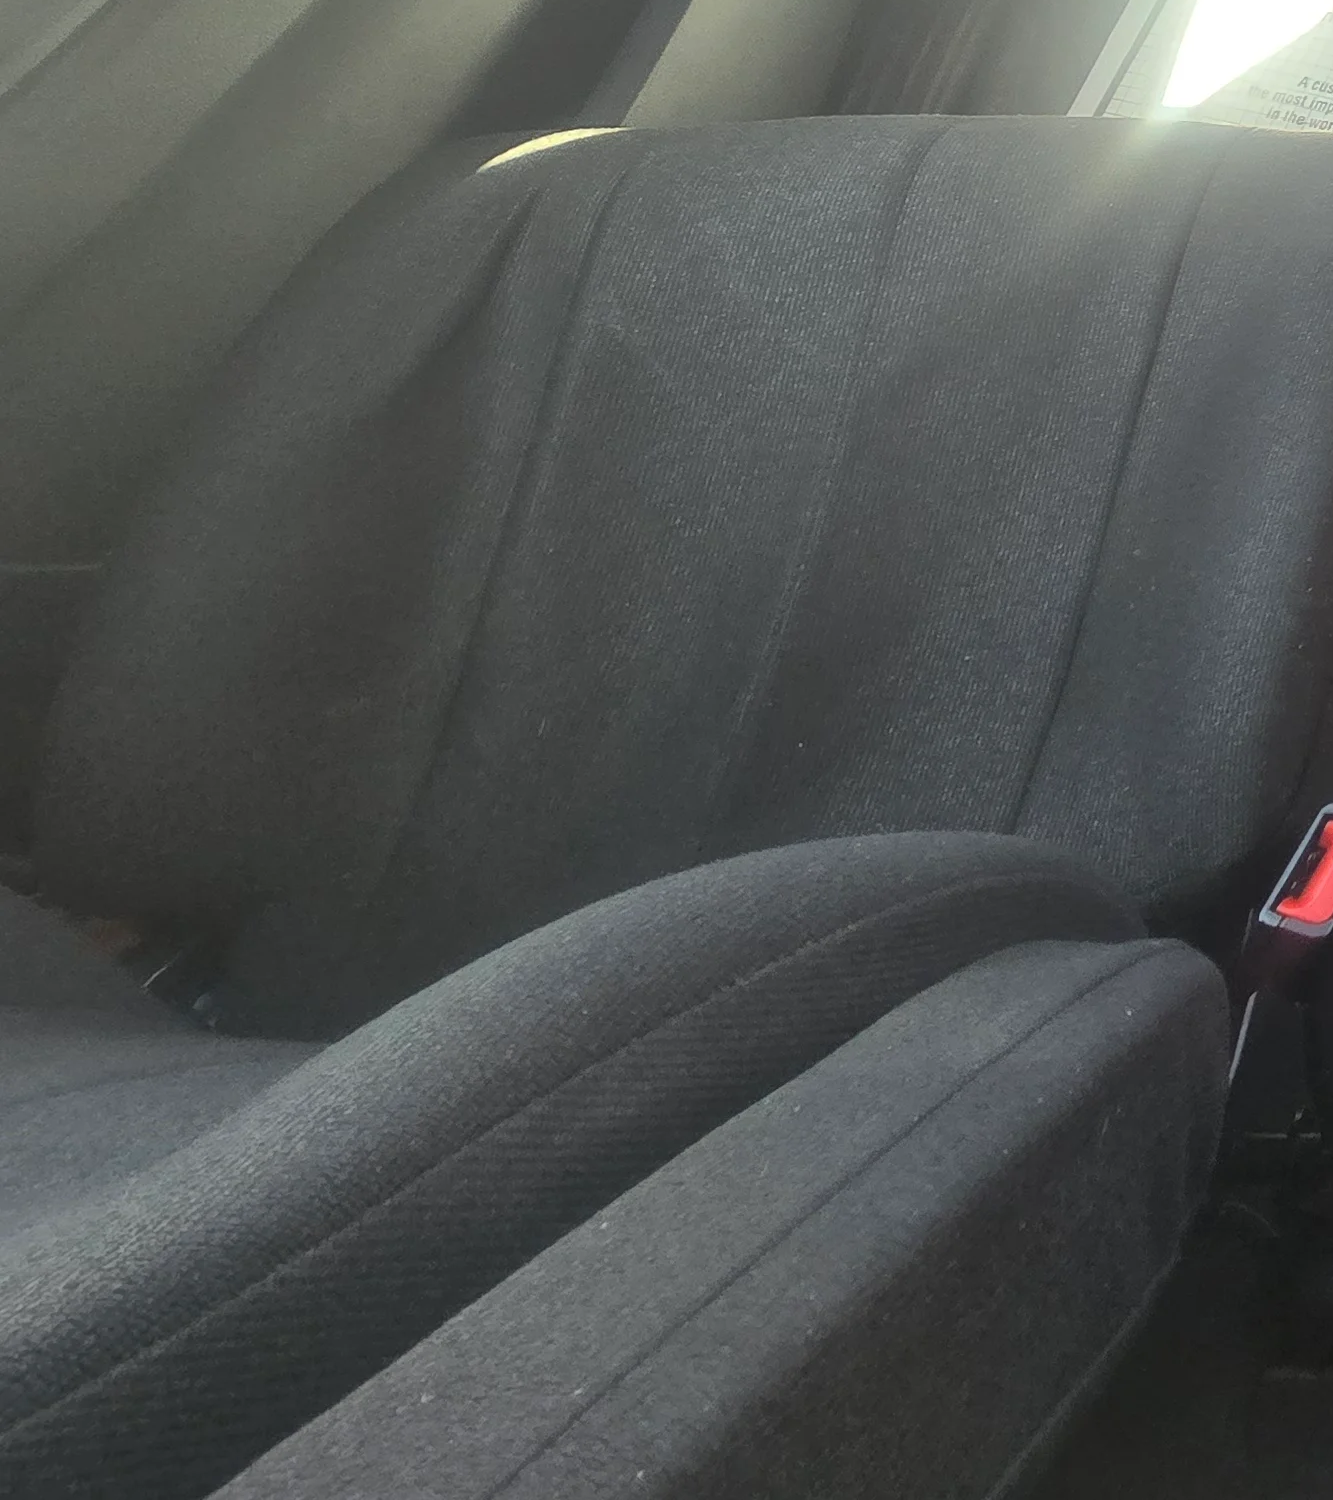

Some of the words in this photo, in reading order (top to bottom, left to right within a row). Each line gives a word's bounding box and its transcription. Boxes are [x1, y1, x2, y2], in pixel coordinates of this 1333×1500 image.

[1297, 76, 1308, 88] A
[1272, 90, 1308, 107] most
[1283, 111, 1305, 126] the
